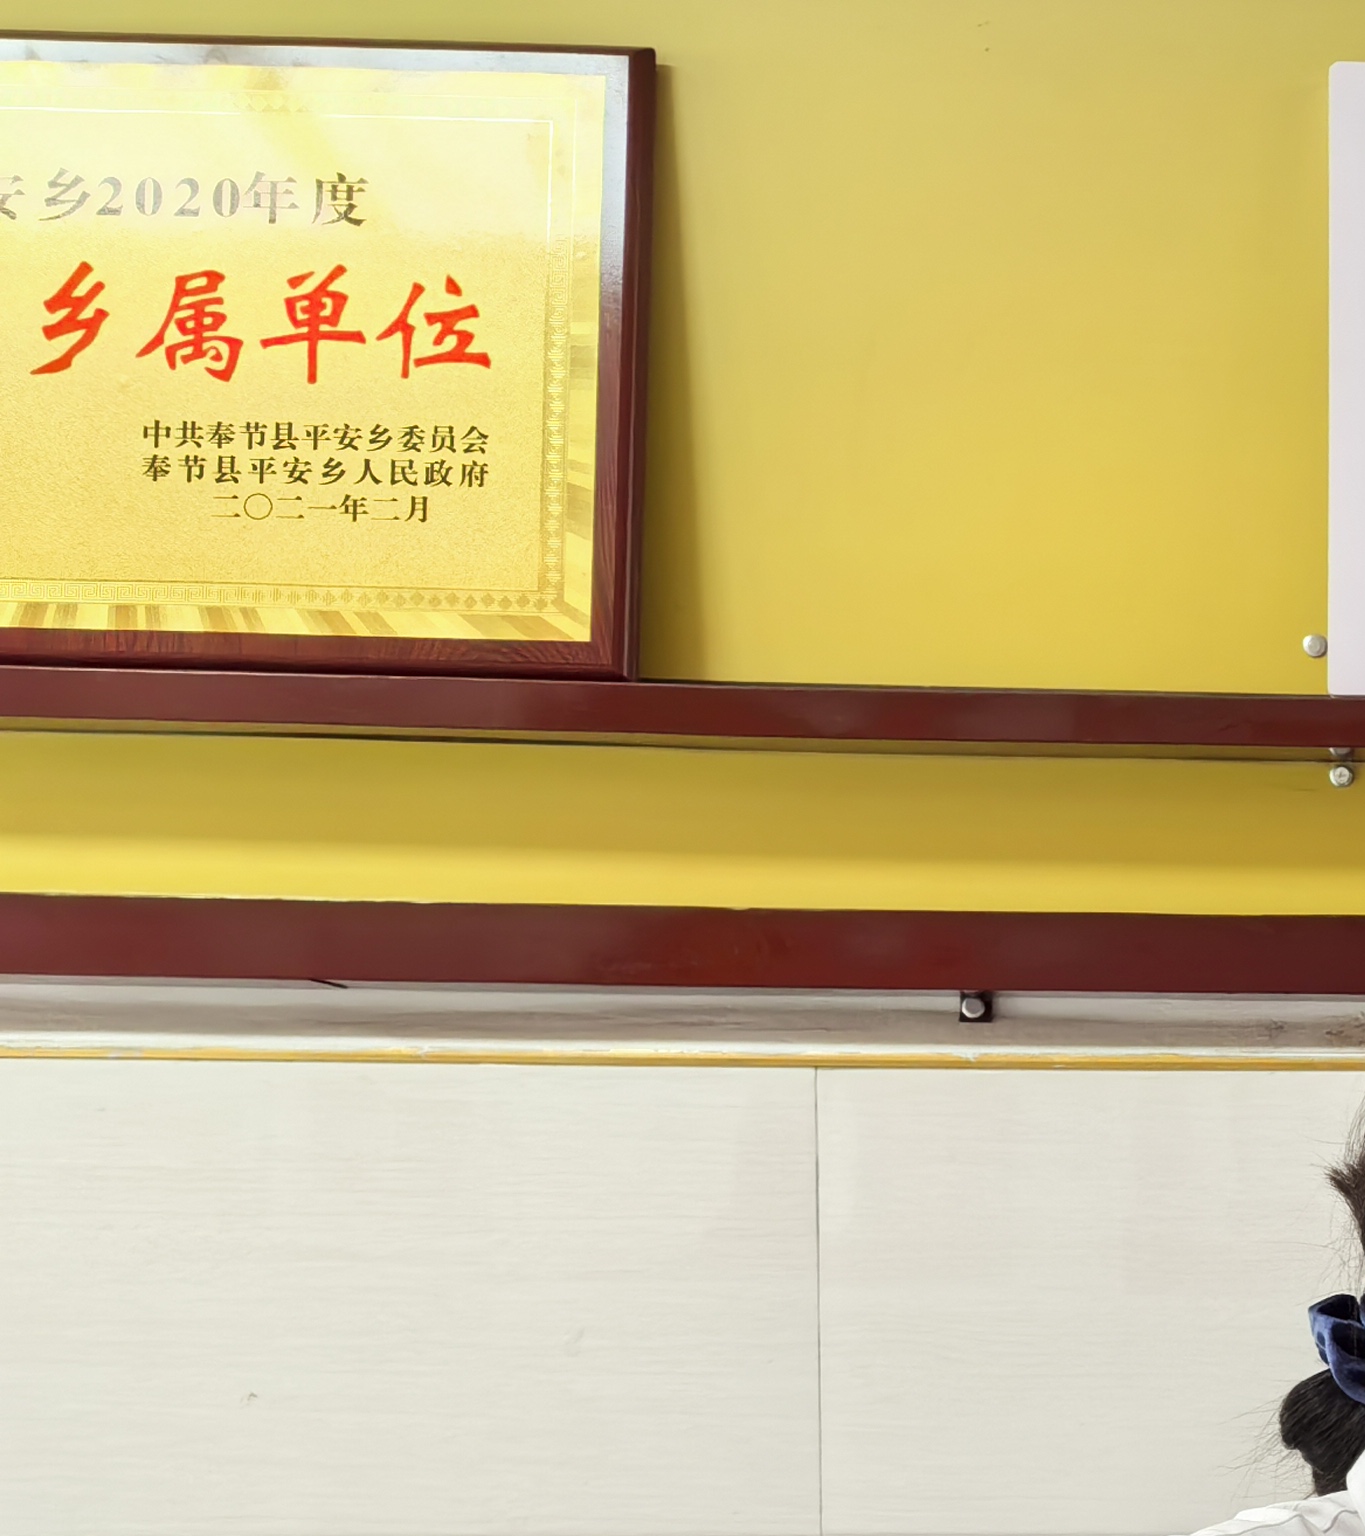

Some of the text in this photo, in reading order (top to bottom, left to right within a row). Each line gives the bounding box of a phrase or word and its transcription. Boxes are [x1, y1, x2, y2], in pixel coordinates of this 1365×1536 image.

[30, 261, 492, 385] 乡属单位
[142, 419, 490, 455] 中共奉节县平安乡委员会
[142, 454, 490, 488] 奉节县平安乡人民政府
